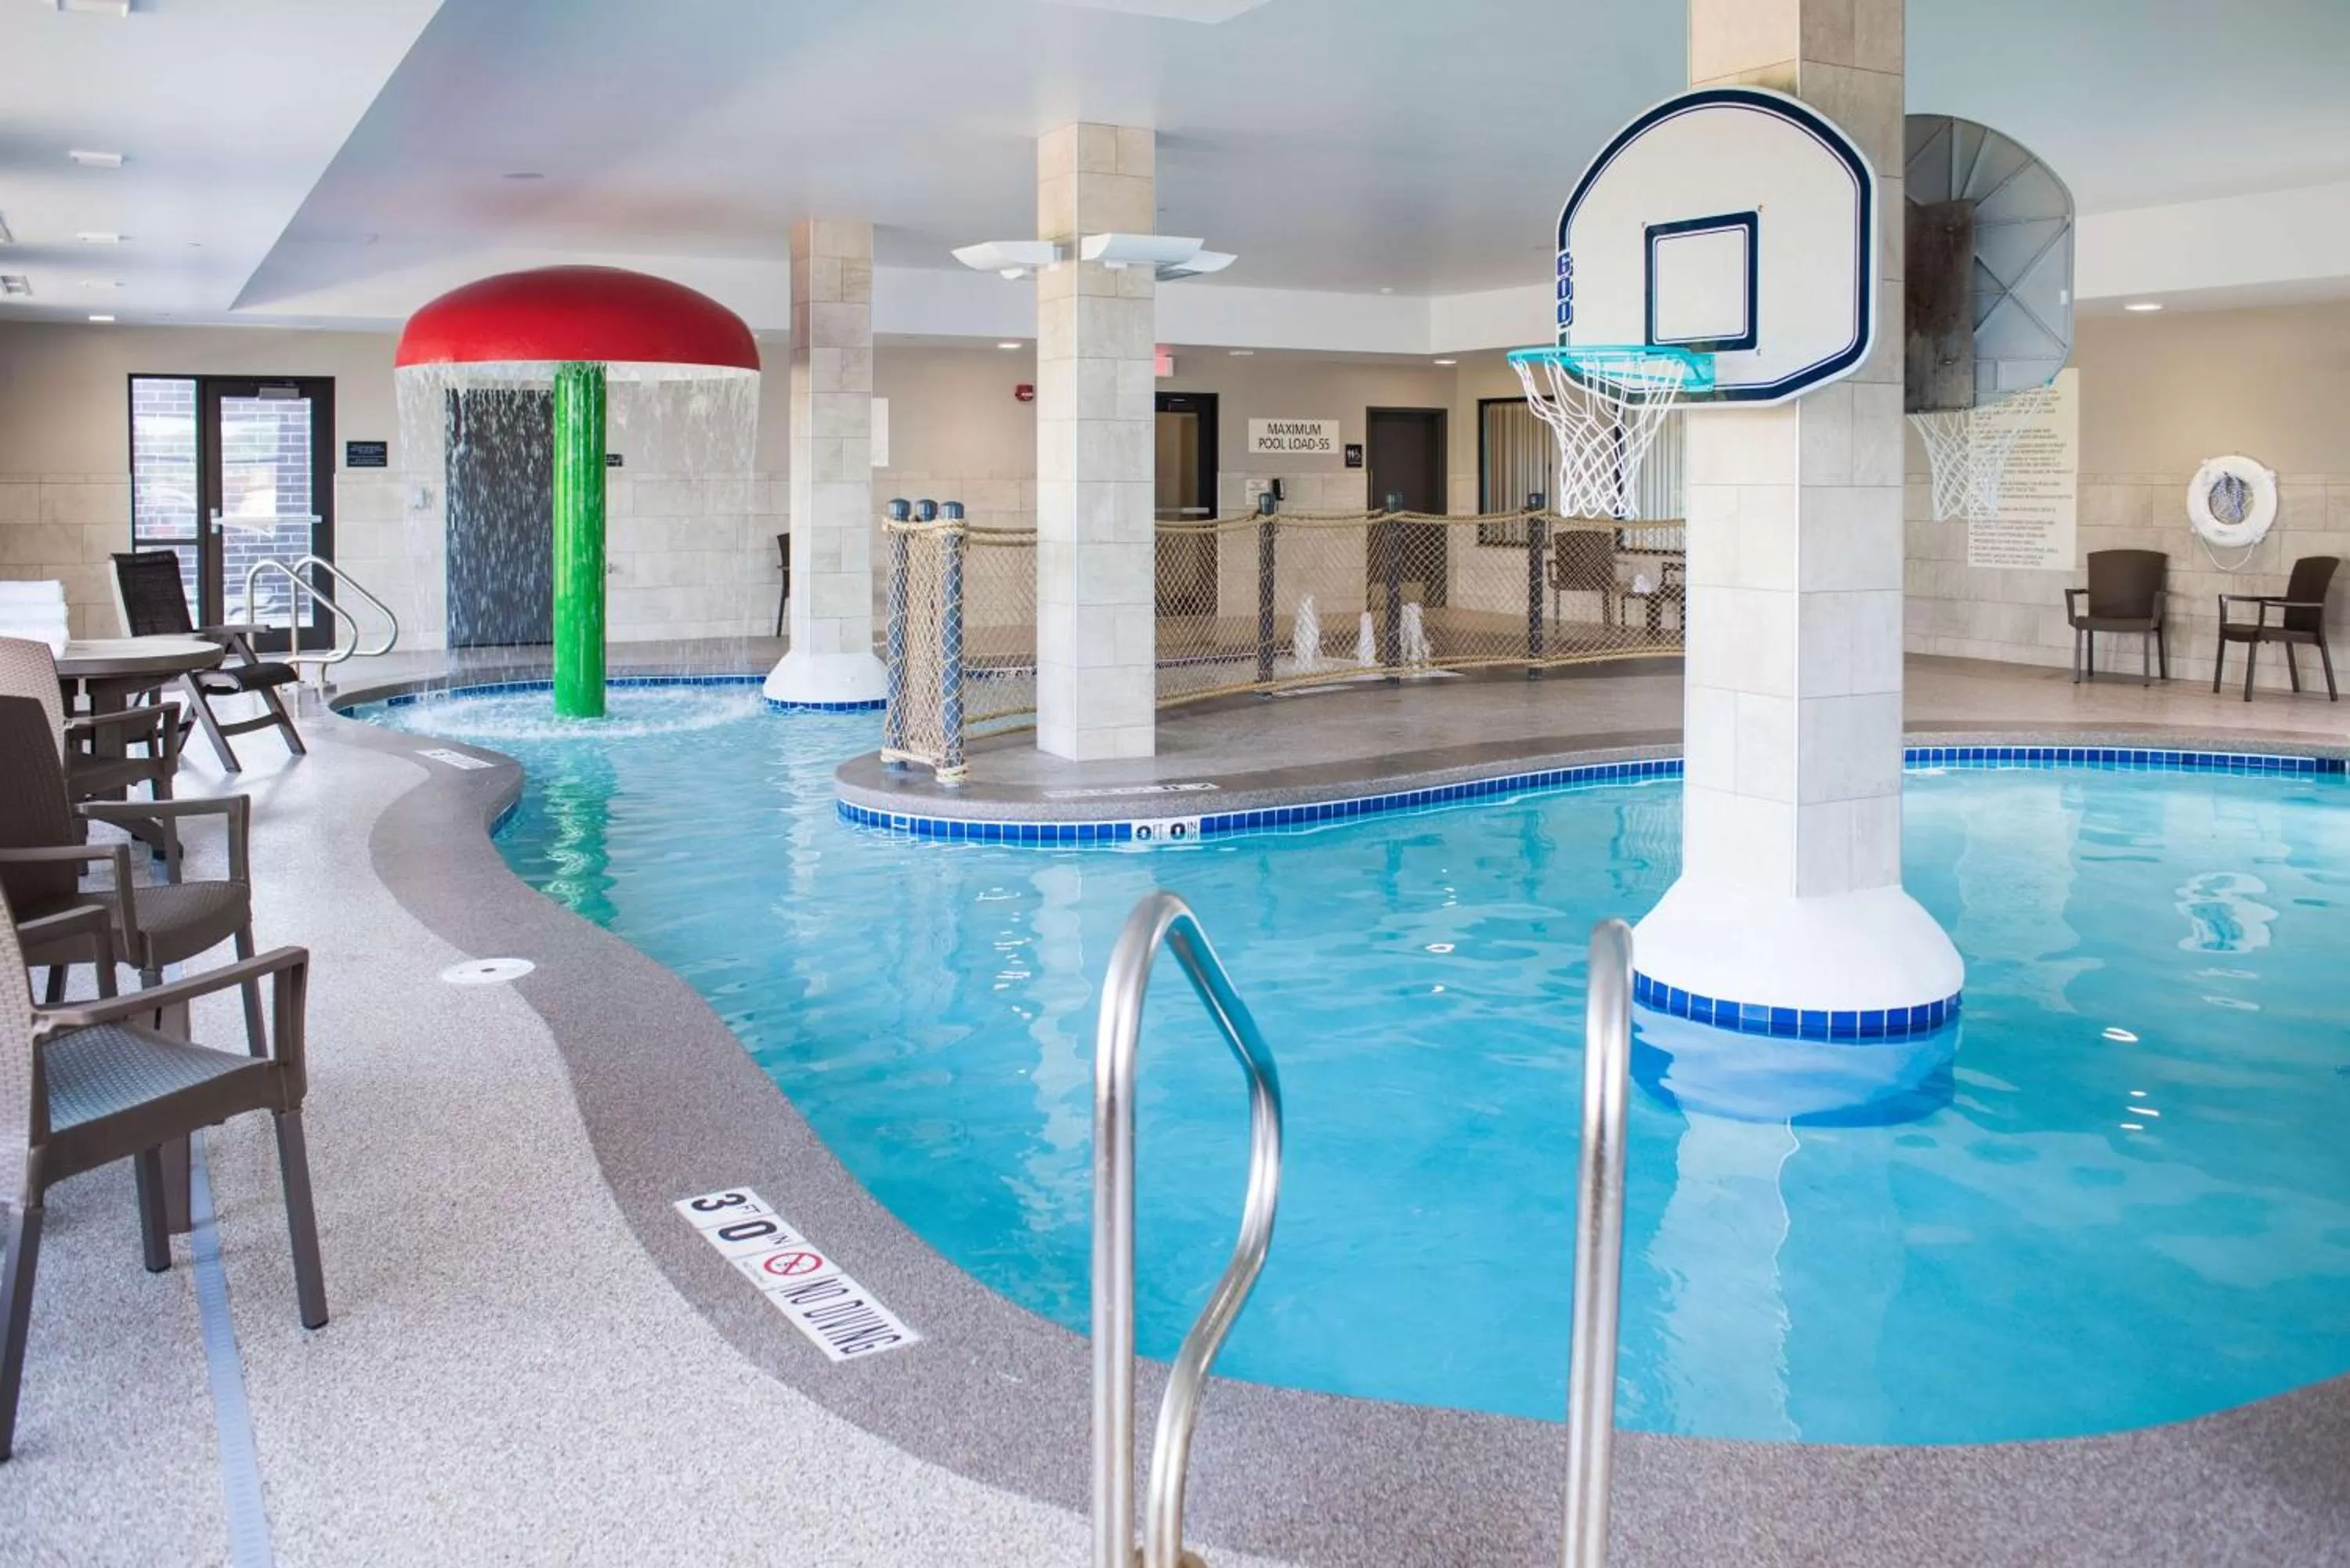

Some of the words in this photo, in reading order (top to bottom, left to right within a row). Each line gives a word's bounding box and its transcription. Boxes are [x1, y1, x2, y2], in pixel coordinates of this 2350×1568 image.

[1267, 423, 1321, 435] MAXIMUM
[1258, 438, 1285, 450] POOL
[1289, 439, 1330, 450] LOAD-55
[779, 1278, 849, 1304] NO
[802, 1299, 902, 1354] DIVING
